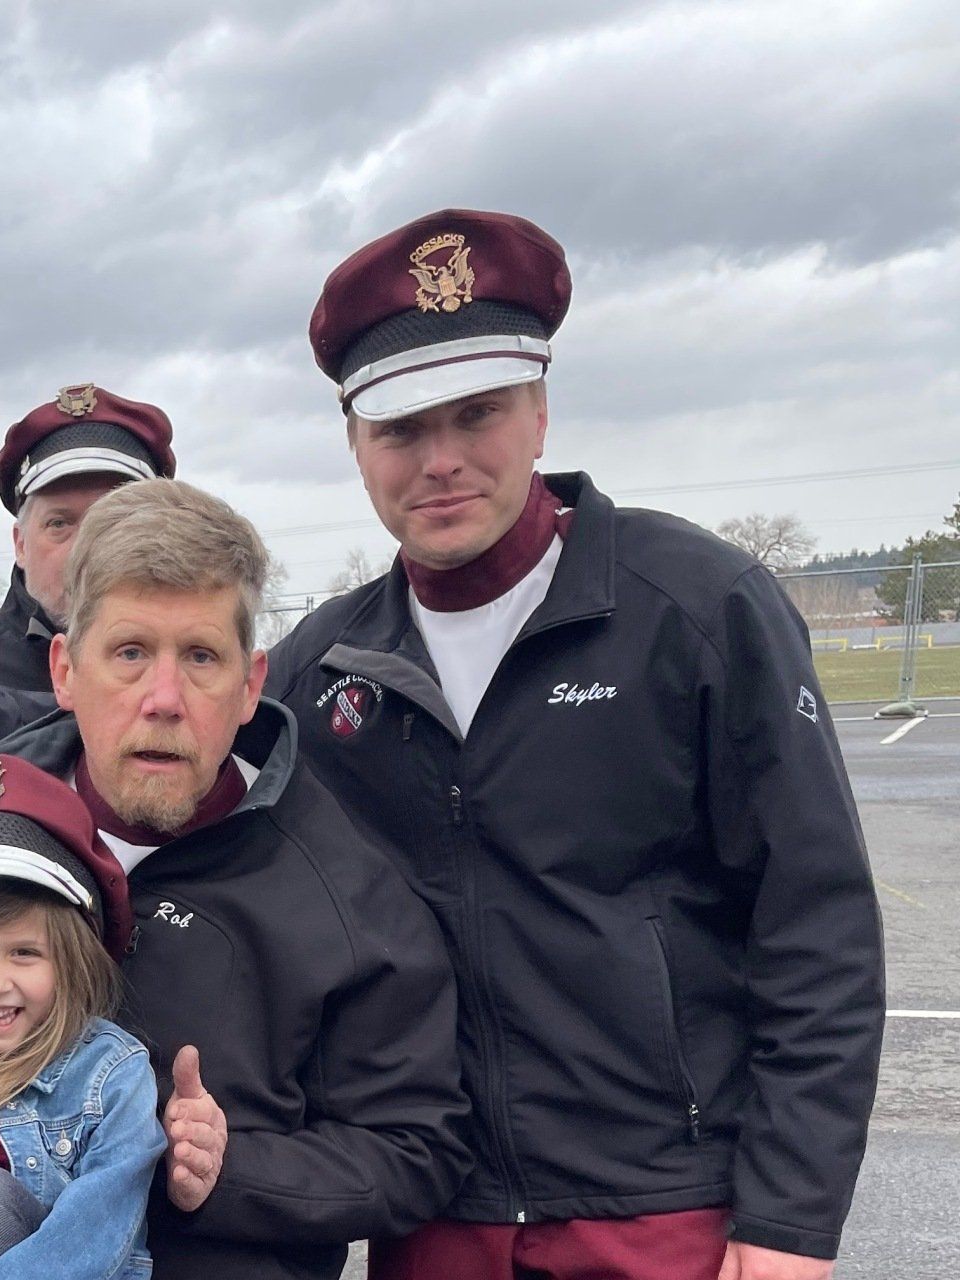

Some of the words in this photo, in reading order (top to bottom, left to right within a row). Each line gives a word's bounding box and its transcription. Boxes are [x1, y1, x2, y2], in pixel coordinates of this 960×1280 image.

[409, 234, 465, 263] COSSACKS
[316, 674, 351, 708] SEATTLE
[547, 682, 618, 707] Skyler
[153, 901, 194, 928] Rob
